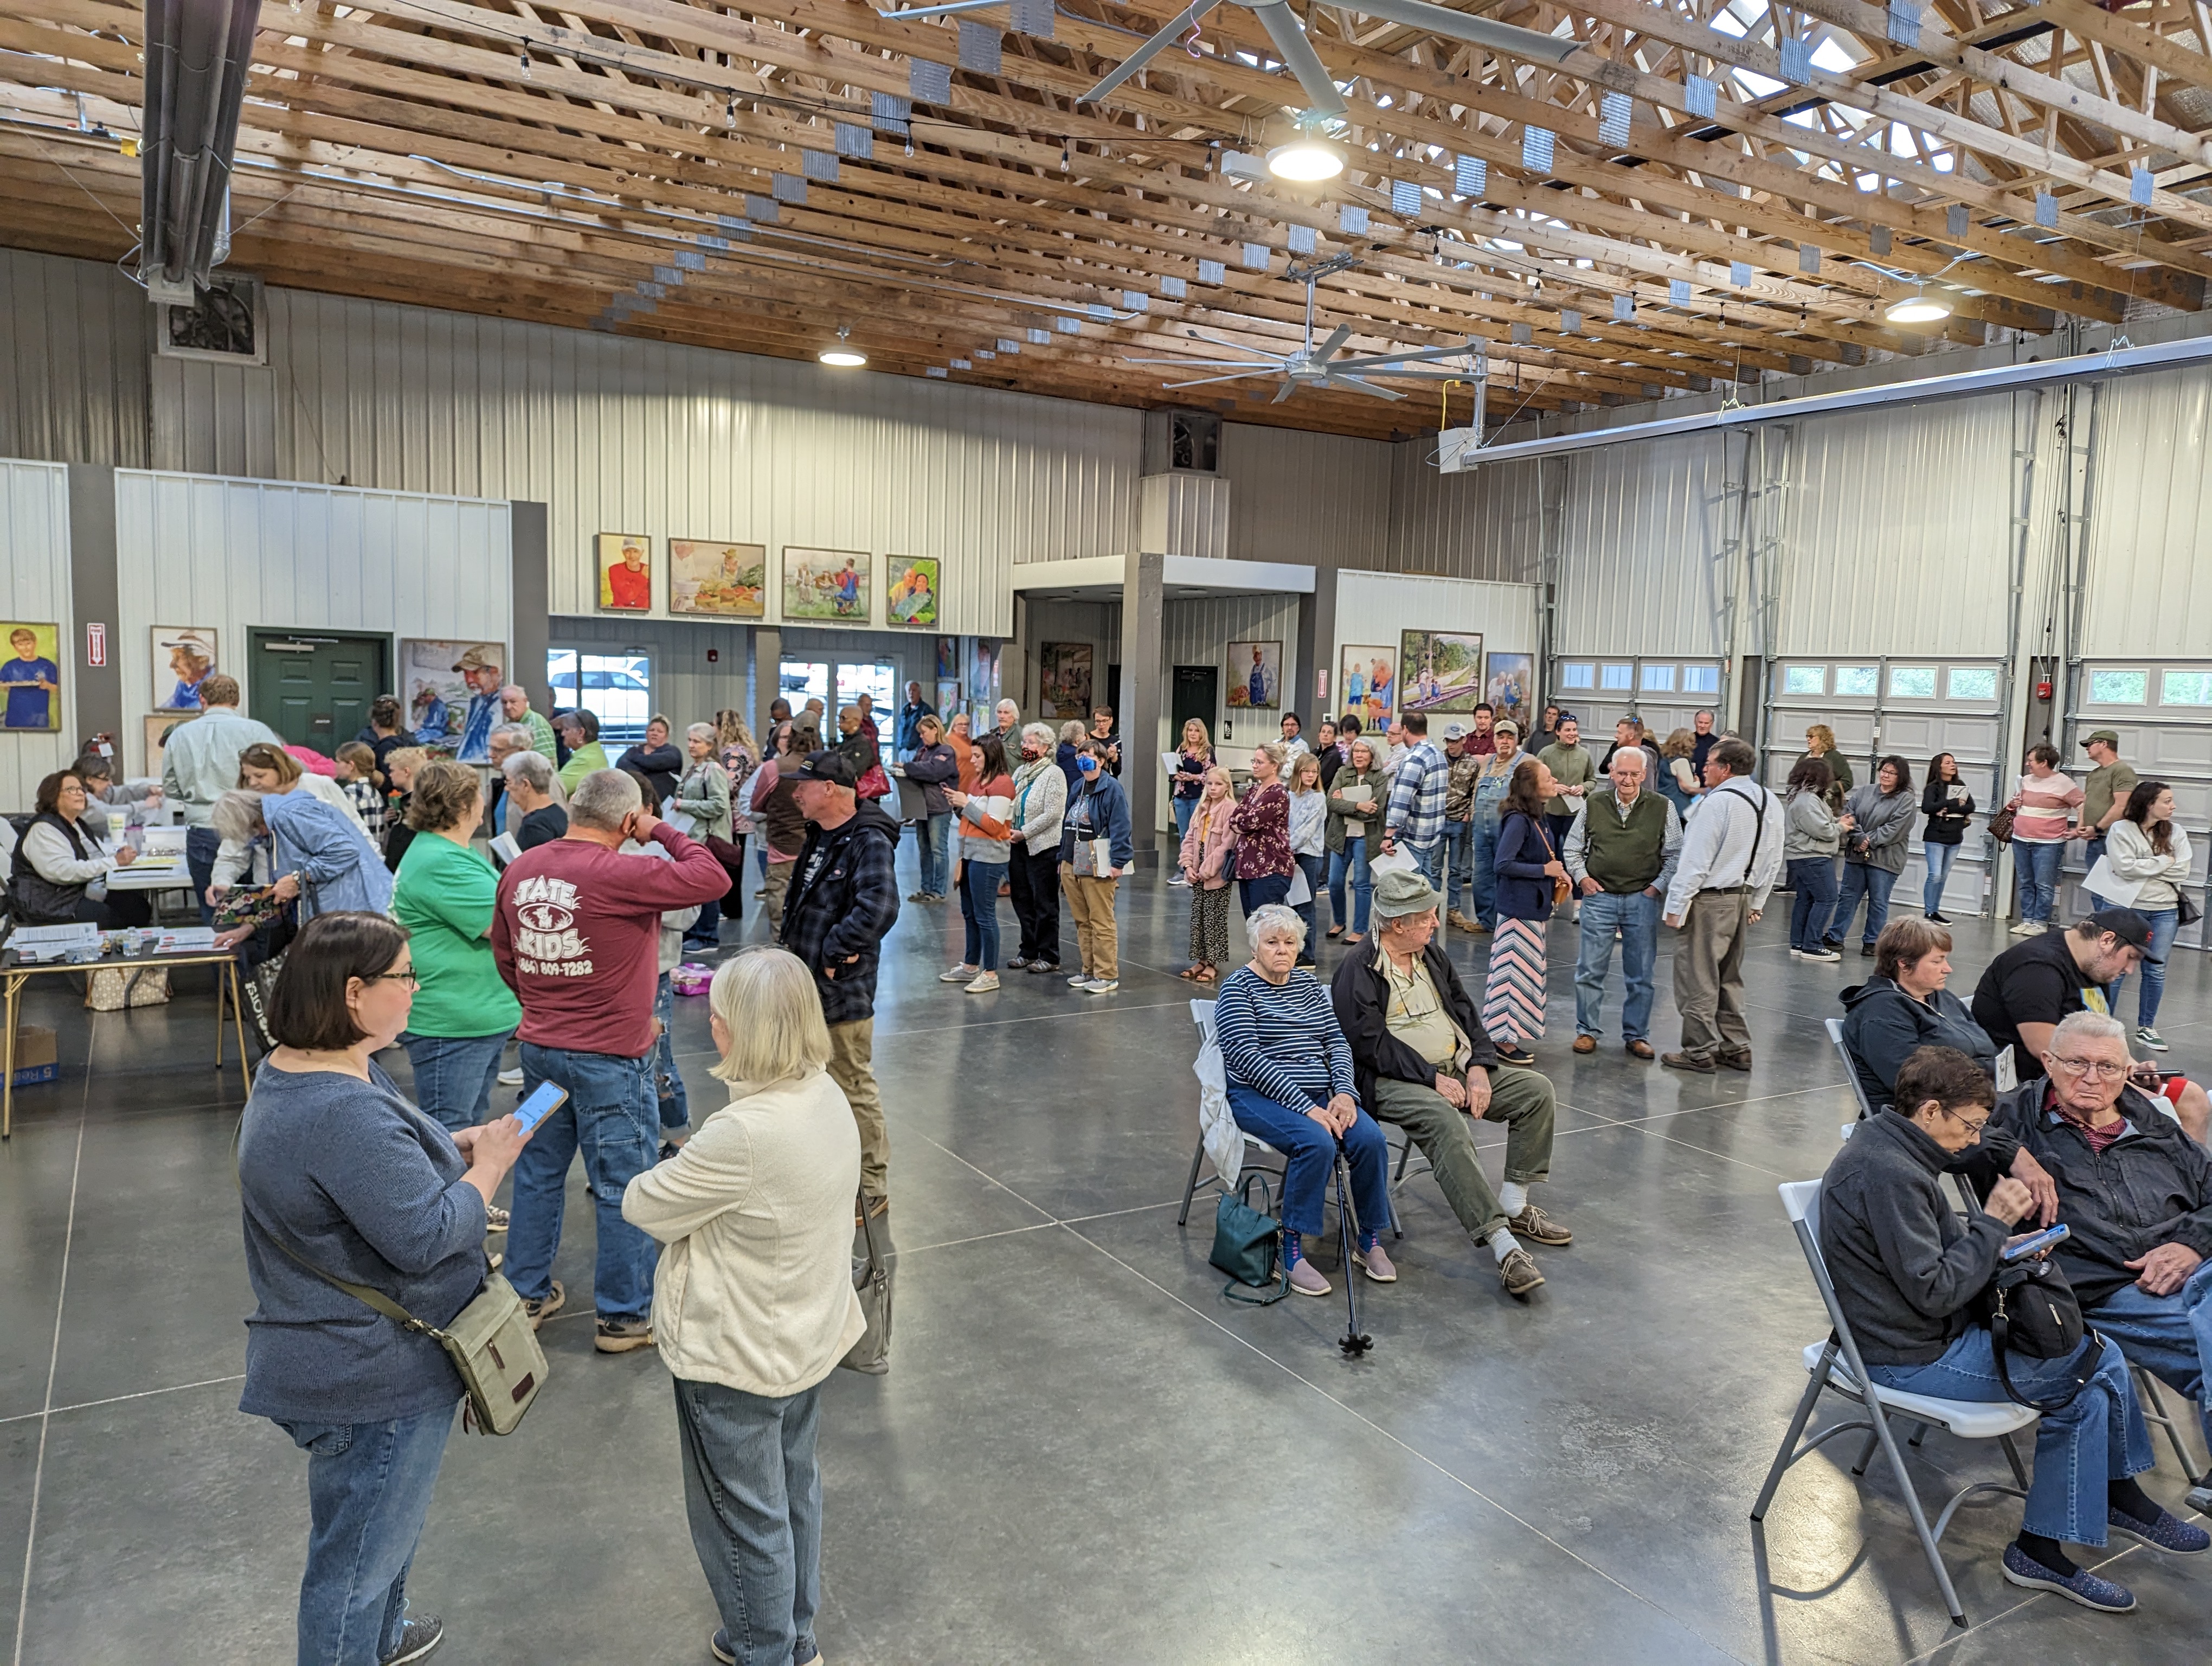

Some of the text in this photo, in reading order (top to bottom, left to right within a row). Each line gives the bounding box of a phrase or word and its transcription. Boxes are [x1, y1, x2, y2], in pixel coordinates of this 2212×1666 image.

[517, 875, 577, 910] TATE
[519, 927, 582, 962] KIDS
[518, 956, 593, 976] (864) 809-7282
